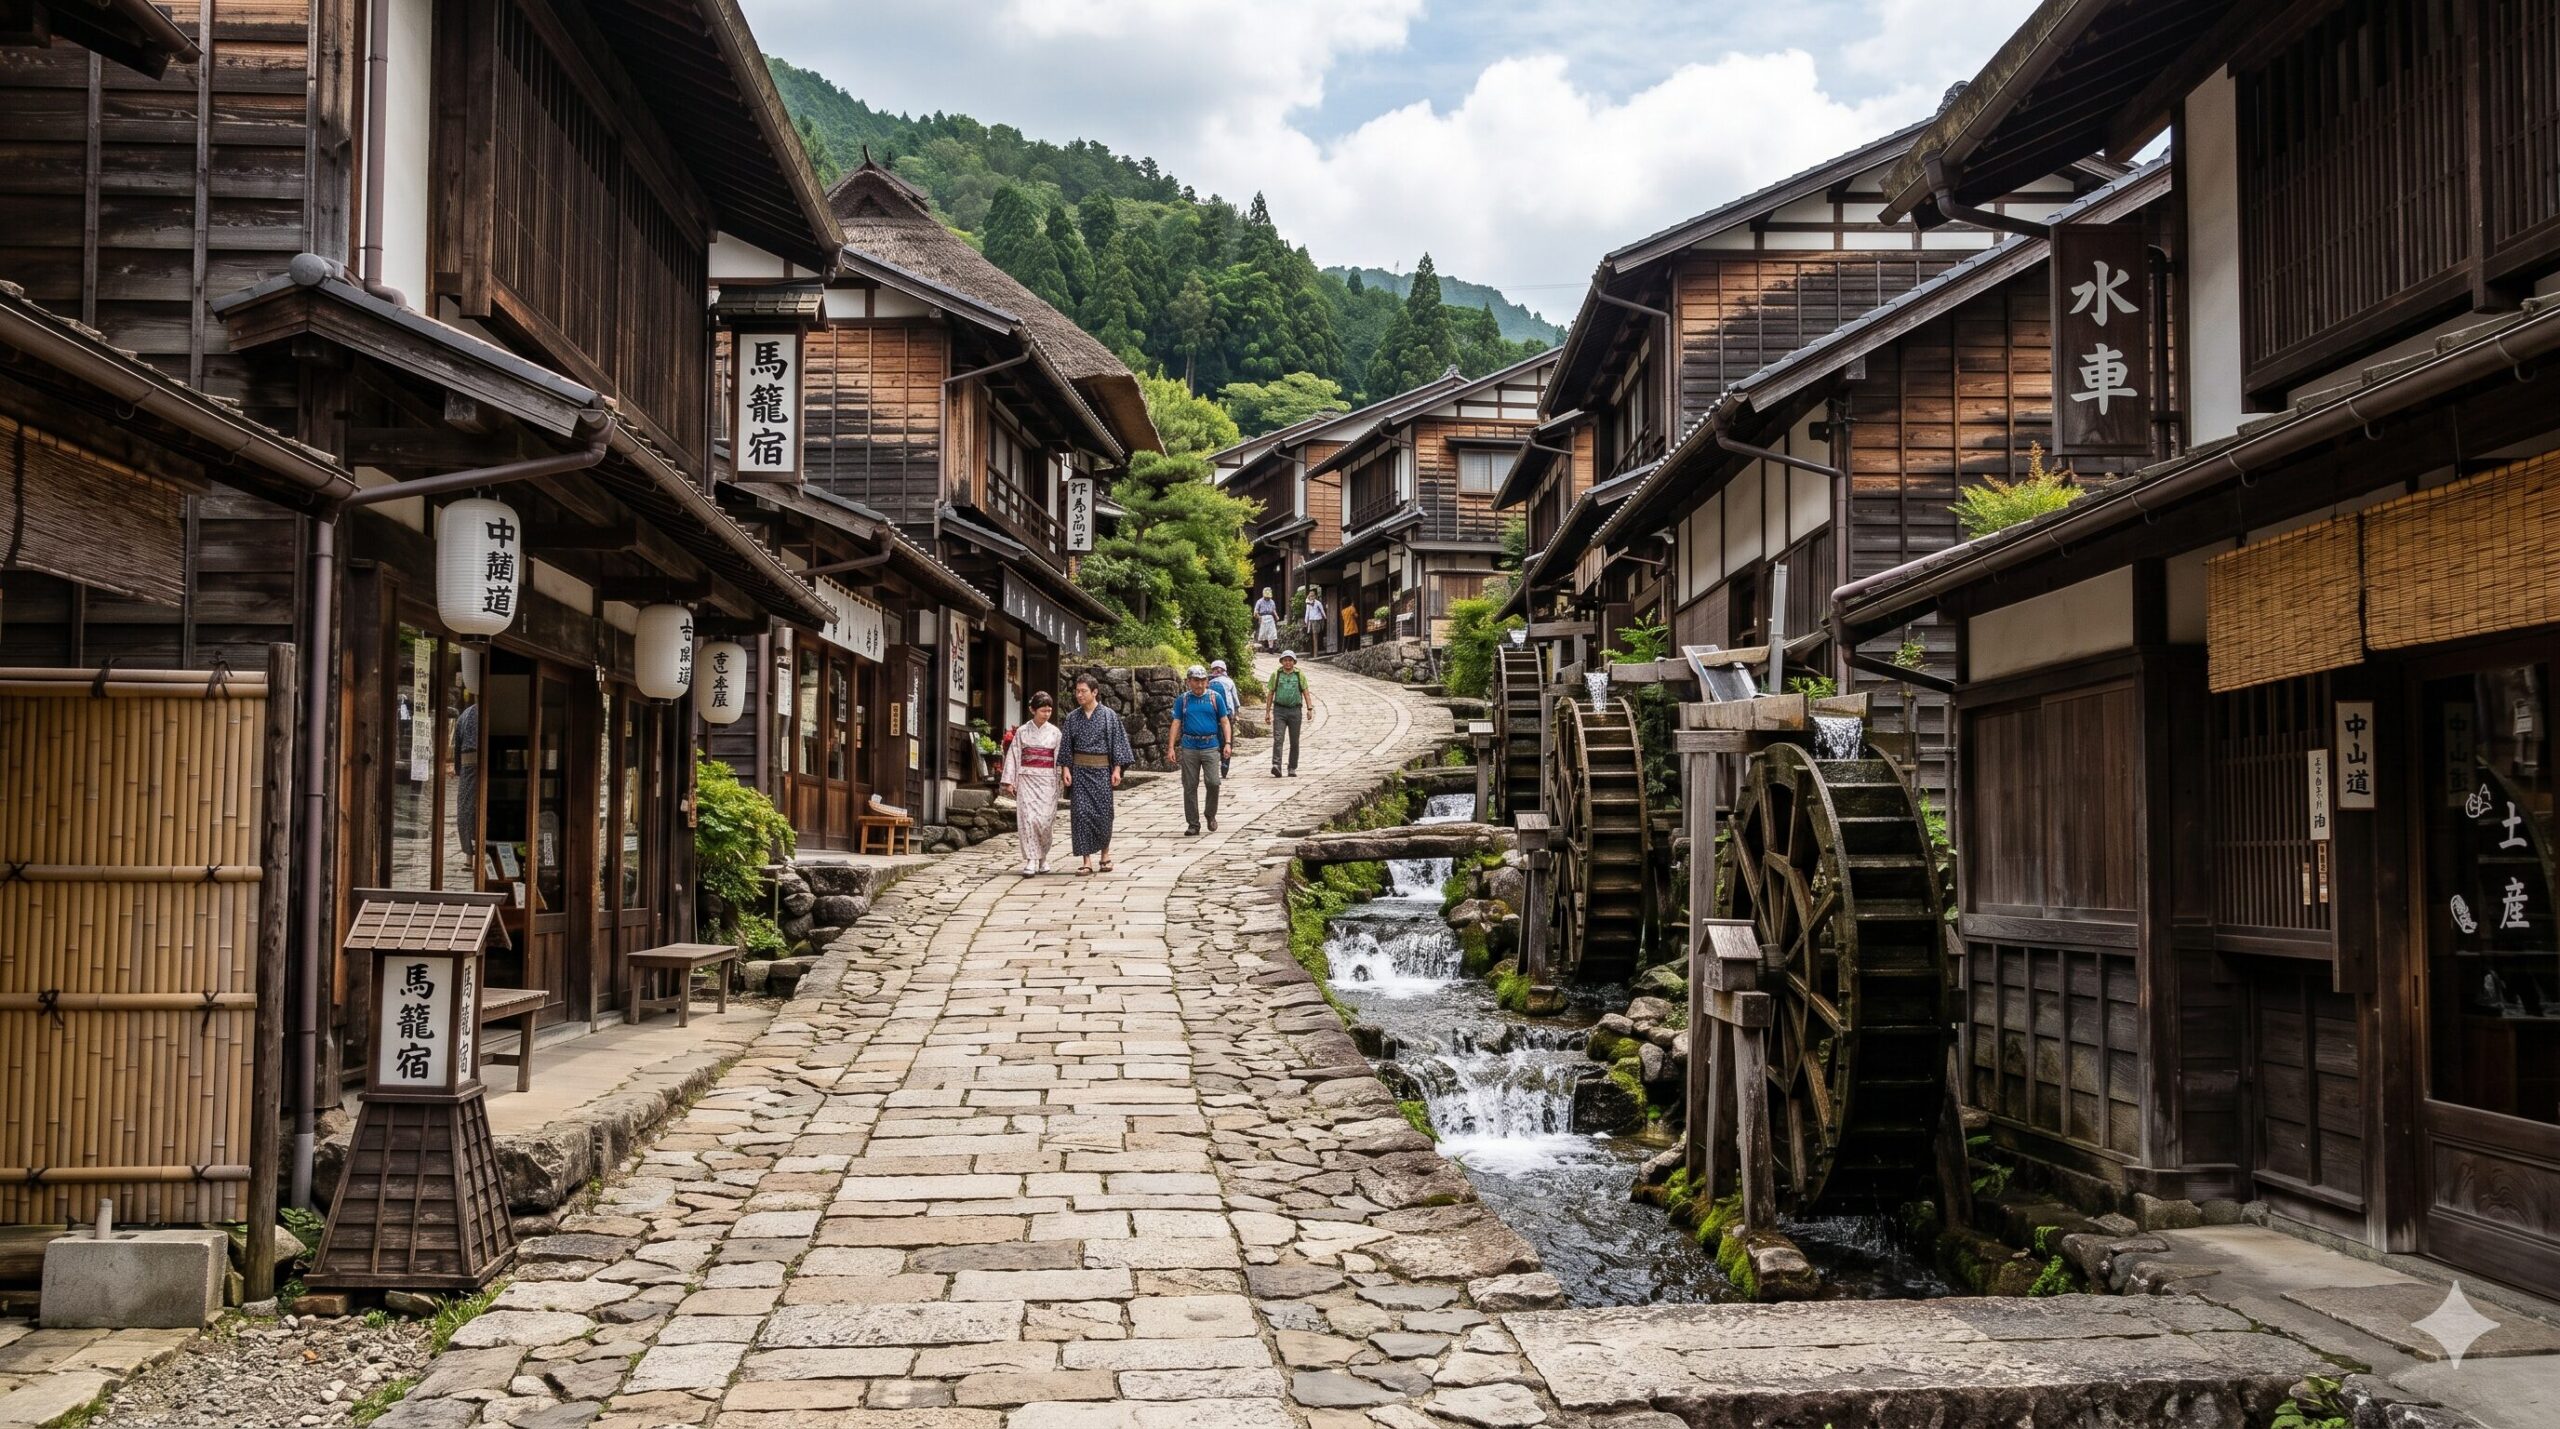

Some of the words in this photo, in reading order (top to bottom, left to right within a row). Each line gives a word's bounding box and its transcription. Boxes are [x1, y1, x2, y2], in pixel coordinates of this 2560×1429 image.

[2069, 260, 2140, 416] 水車
[746, 340, 789, 466] 馬籠宿
[2344, 713, 2371, 796] 中山道
[2499, 801, 2531, 930] 土産
[396, 963, 435, 1079] 馬籠宿
